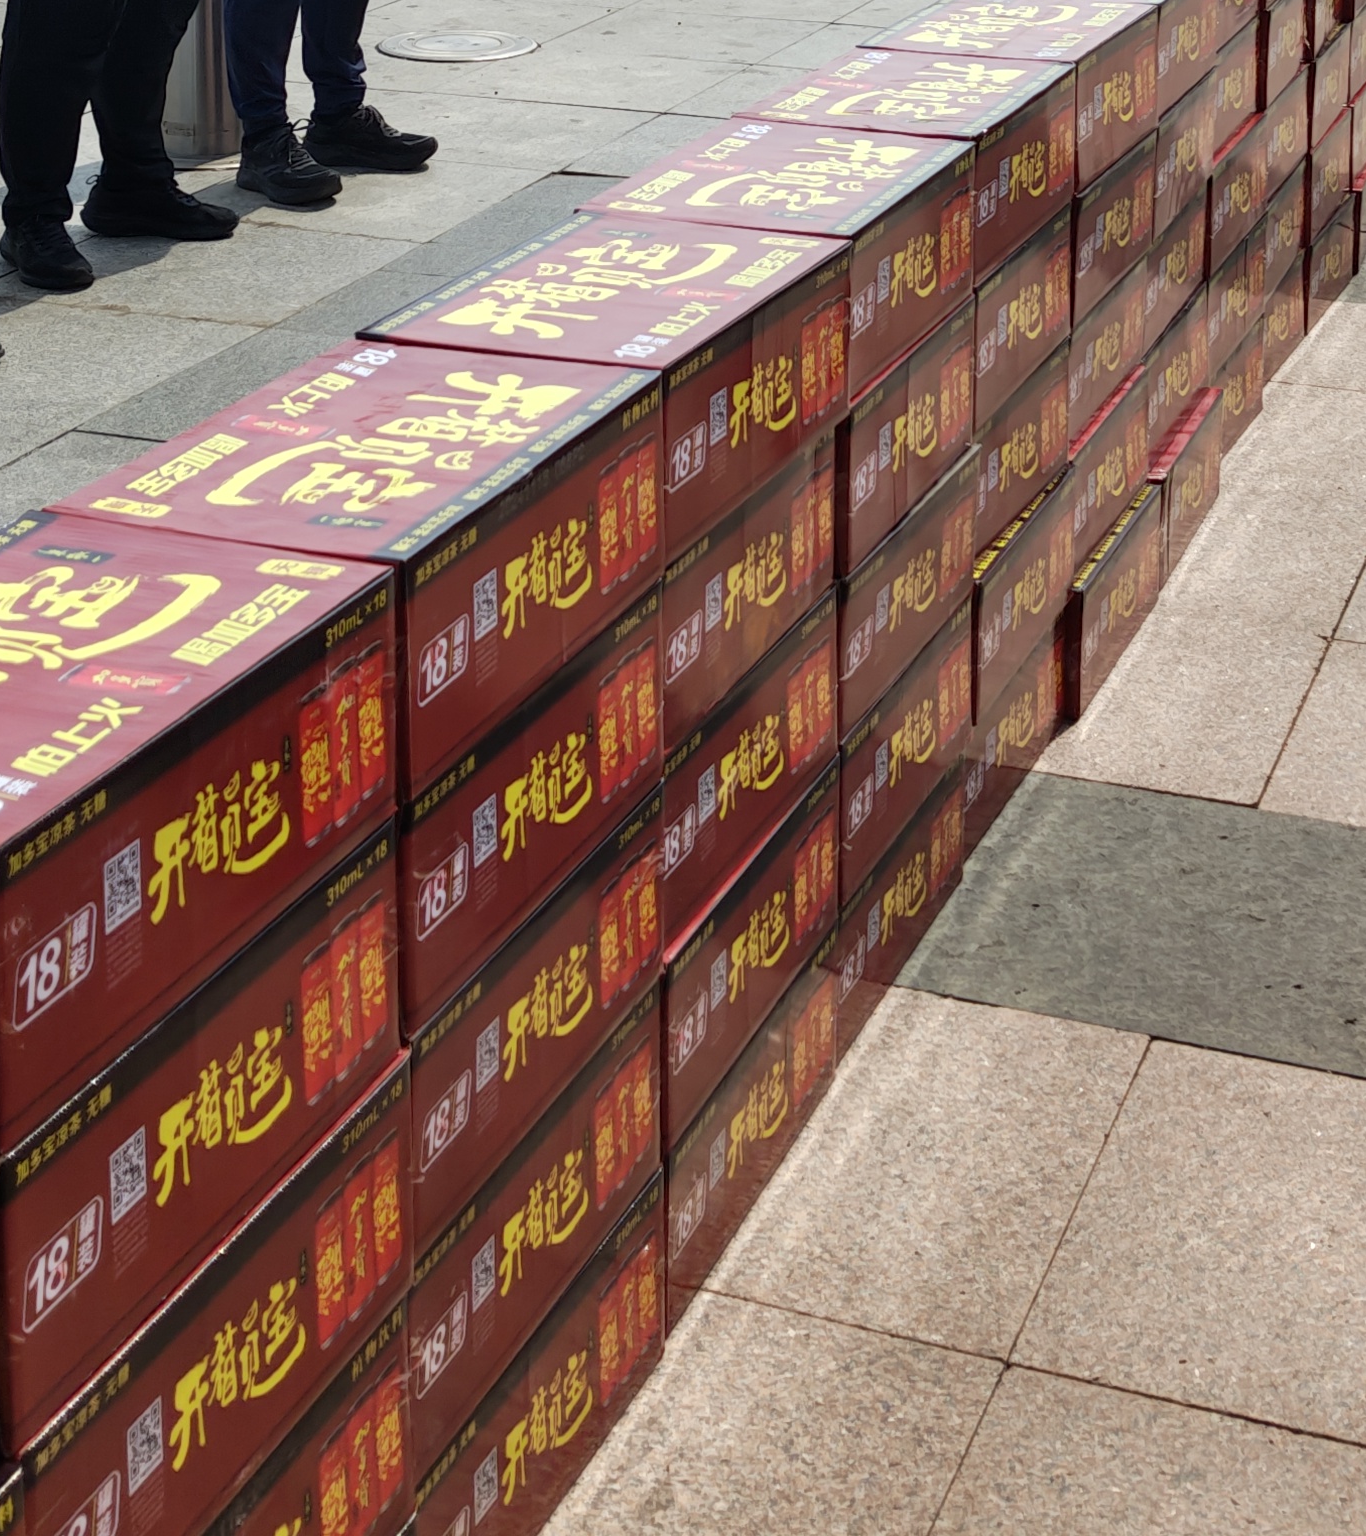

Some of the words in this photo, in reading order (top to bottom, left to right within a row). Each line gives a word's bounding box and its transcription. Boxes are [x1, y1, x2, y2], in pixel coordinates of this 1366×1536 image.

[979, 190, 988, 222] 18
[648, 301, 721, 336] 怕上火
[852, 296, 866, 332] 18
[352, 348, 398, 366] 18
[614, 342, 658, 359] 18
[270, 373, 354, 416] 怕上火
[729, 355, 798, 448] 开箱见宝
[127, 434, 252, 500] 喝加多宝
[673, 439, 691, 482] 18
[854, 472, 866, 504] 18
[501, 518, 594, 639] 开箱见宝
[168, 579, 309, 666] 喝加多宝
[421, 638, 448, 693] 18
[668, 631, 687, 675] 18
[848, 642, 863, 672] 18
[12, 697, 142, 776] 怕上火
[500, 732, 594, 862] 开箱见宝
[849, 796, 862, 830] 18
[6, 818, 76, 879] 加多宝凉茶
[79, 788, 109, 826] 无糖
[146, 757, 292, 925] 开箱见宝
[664, 824, 680, 871] 18
[420, 868, 446, 926] 18
[19, 936, 62, 1012] 18
[501, 944, 594, 1082] 开箱见宝
[679, 1016, 694, 1061] 18
[16, 1116, 82, 1187] 加多宝凉茶
[85, 1084, 113, 1124] 无糖
[151, 1025, 294, 1208] 开箱见宝
[425, 1100, 450, 1158] 18
[498, 1149, 590, 1297] 开箱见宝
[28, 1236, 70, 1314] 18
[168, 1277, 308, 1472] 开箱见宝
[421, 1323, 446, 1383] 18
